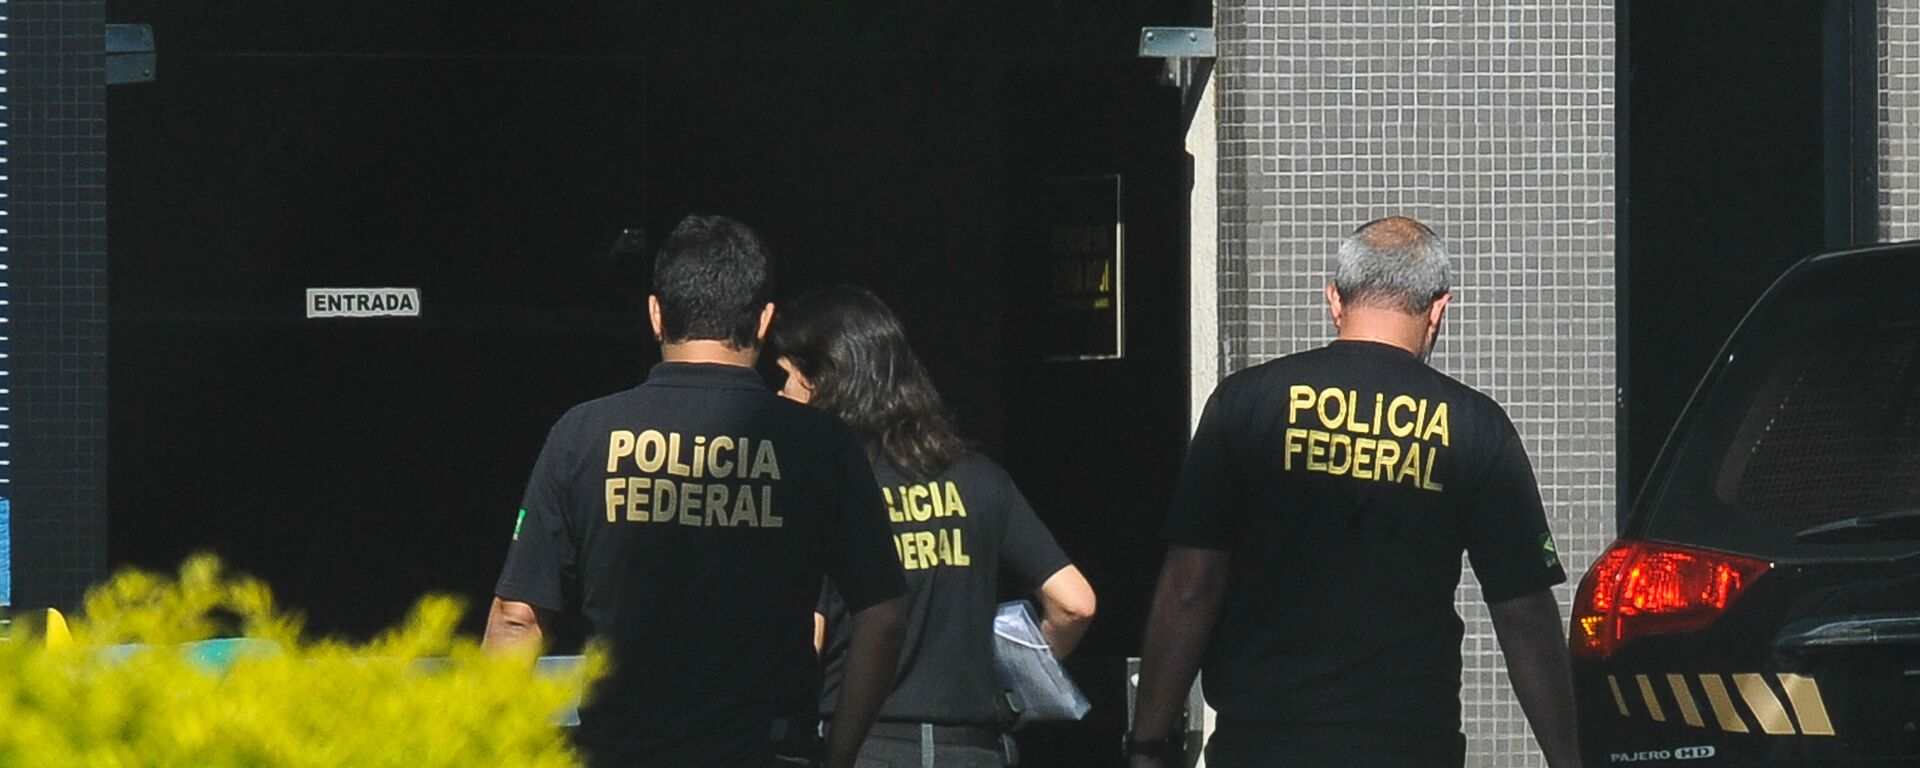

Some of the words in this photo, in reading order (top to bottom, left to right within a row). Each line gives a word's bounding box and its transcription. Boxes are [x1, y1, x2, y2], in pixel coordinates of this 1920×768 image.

[314, 294, 413, 311] ENTRADA
[1284, 427, 1444, 492] FEDERAL
[605, 476, 783, 528] FEDERAL
[893, 528, 971, 570] ERAL
[1610, 750, 1671, 762] PAJERO
[1679, 747, 1711, 759] HD
